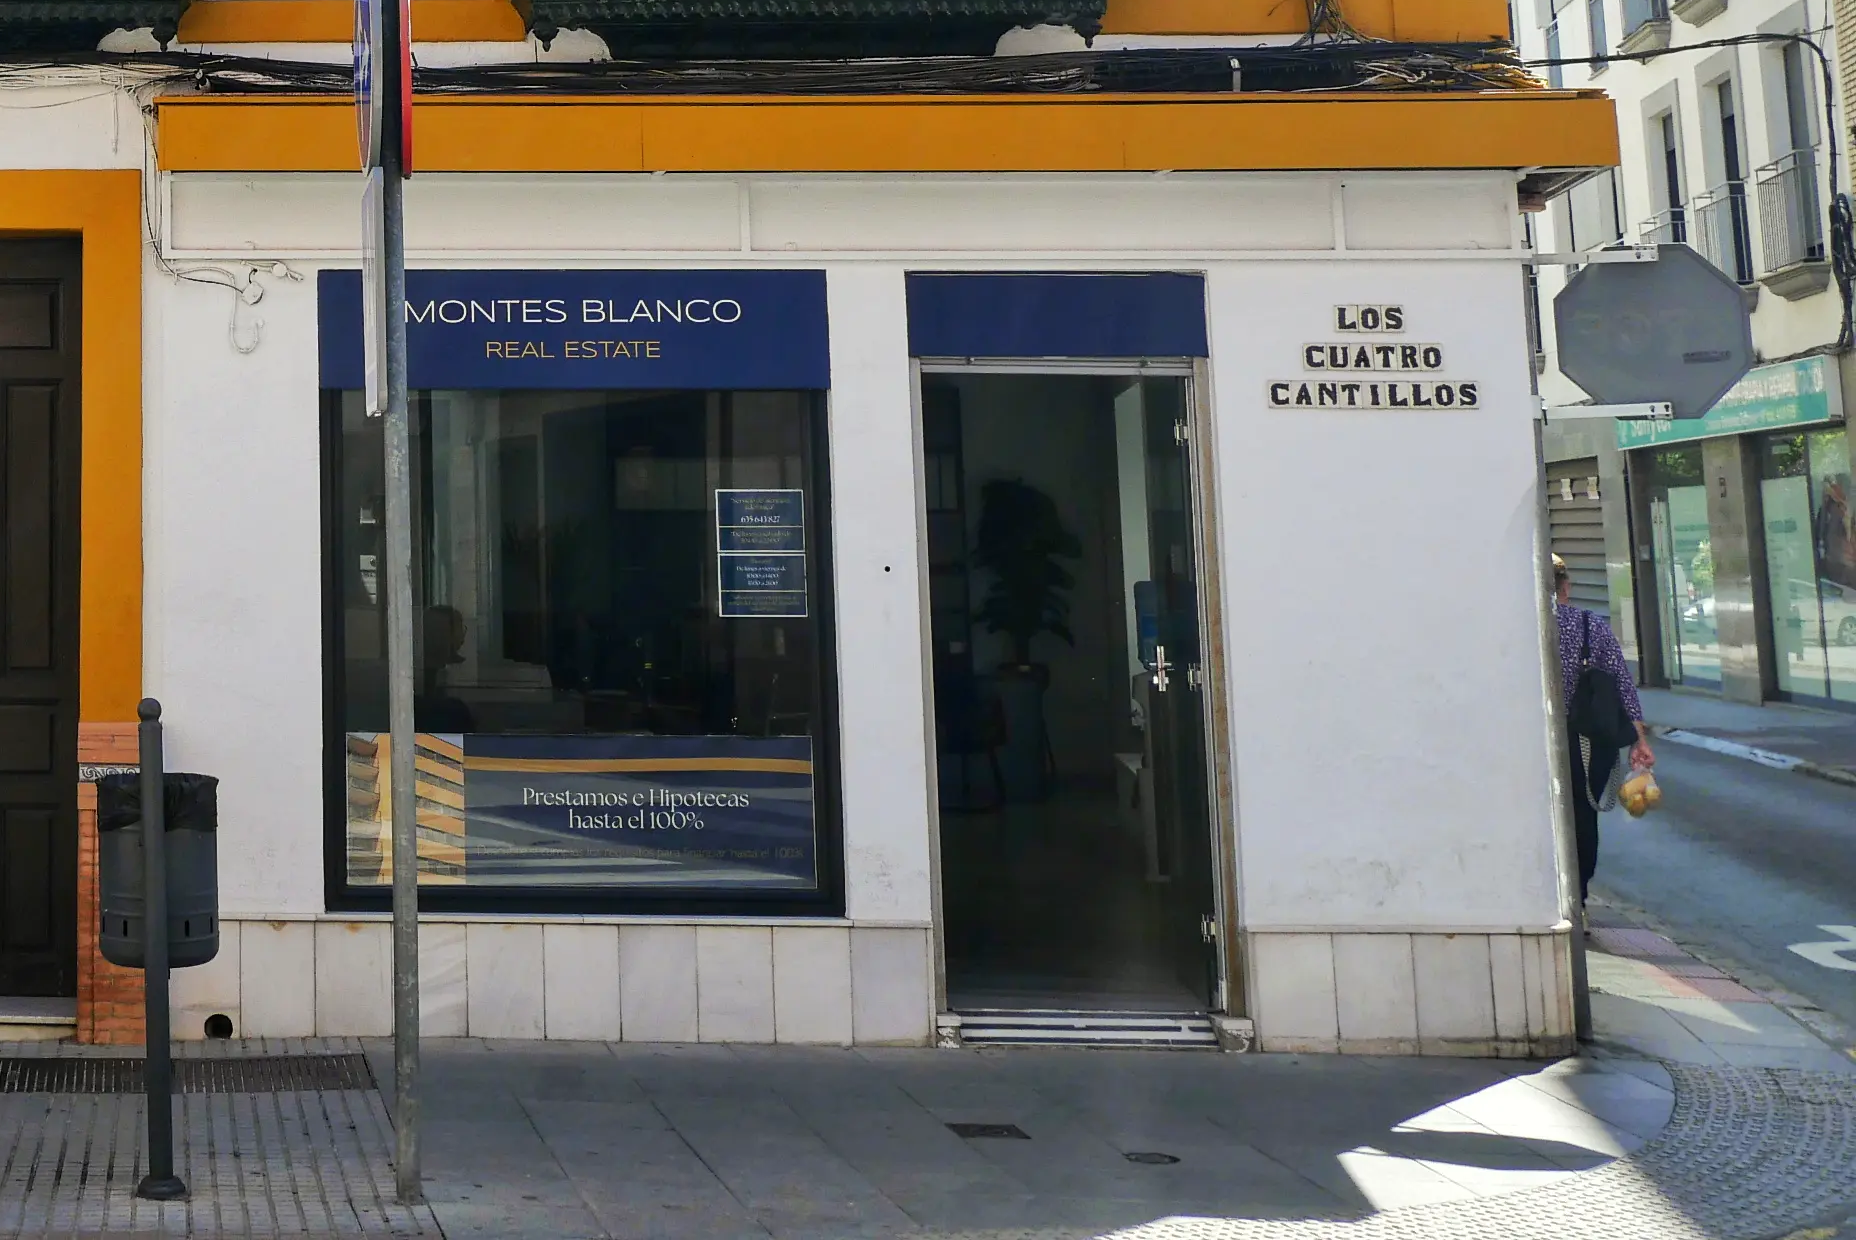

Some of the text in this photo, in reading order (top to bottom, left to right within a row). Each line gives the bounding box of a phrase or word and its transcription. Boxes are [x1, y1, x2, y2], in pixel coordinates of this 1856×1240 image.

[403, 299, 742, 324] MONTES BLANCO
[1337, 306, 1404, 330] LOS
[485, 341, 661, 359] REAL ESTATE
[1305, 345, 1442, 369] CUATRO
[1270, 382, 1478, 406] CANTILLOS
[522, 787, 750, 813] Prestamos e Hipotecas
[568, 809, 705, 831] hasta el 100%
